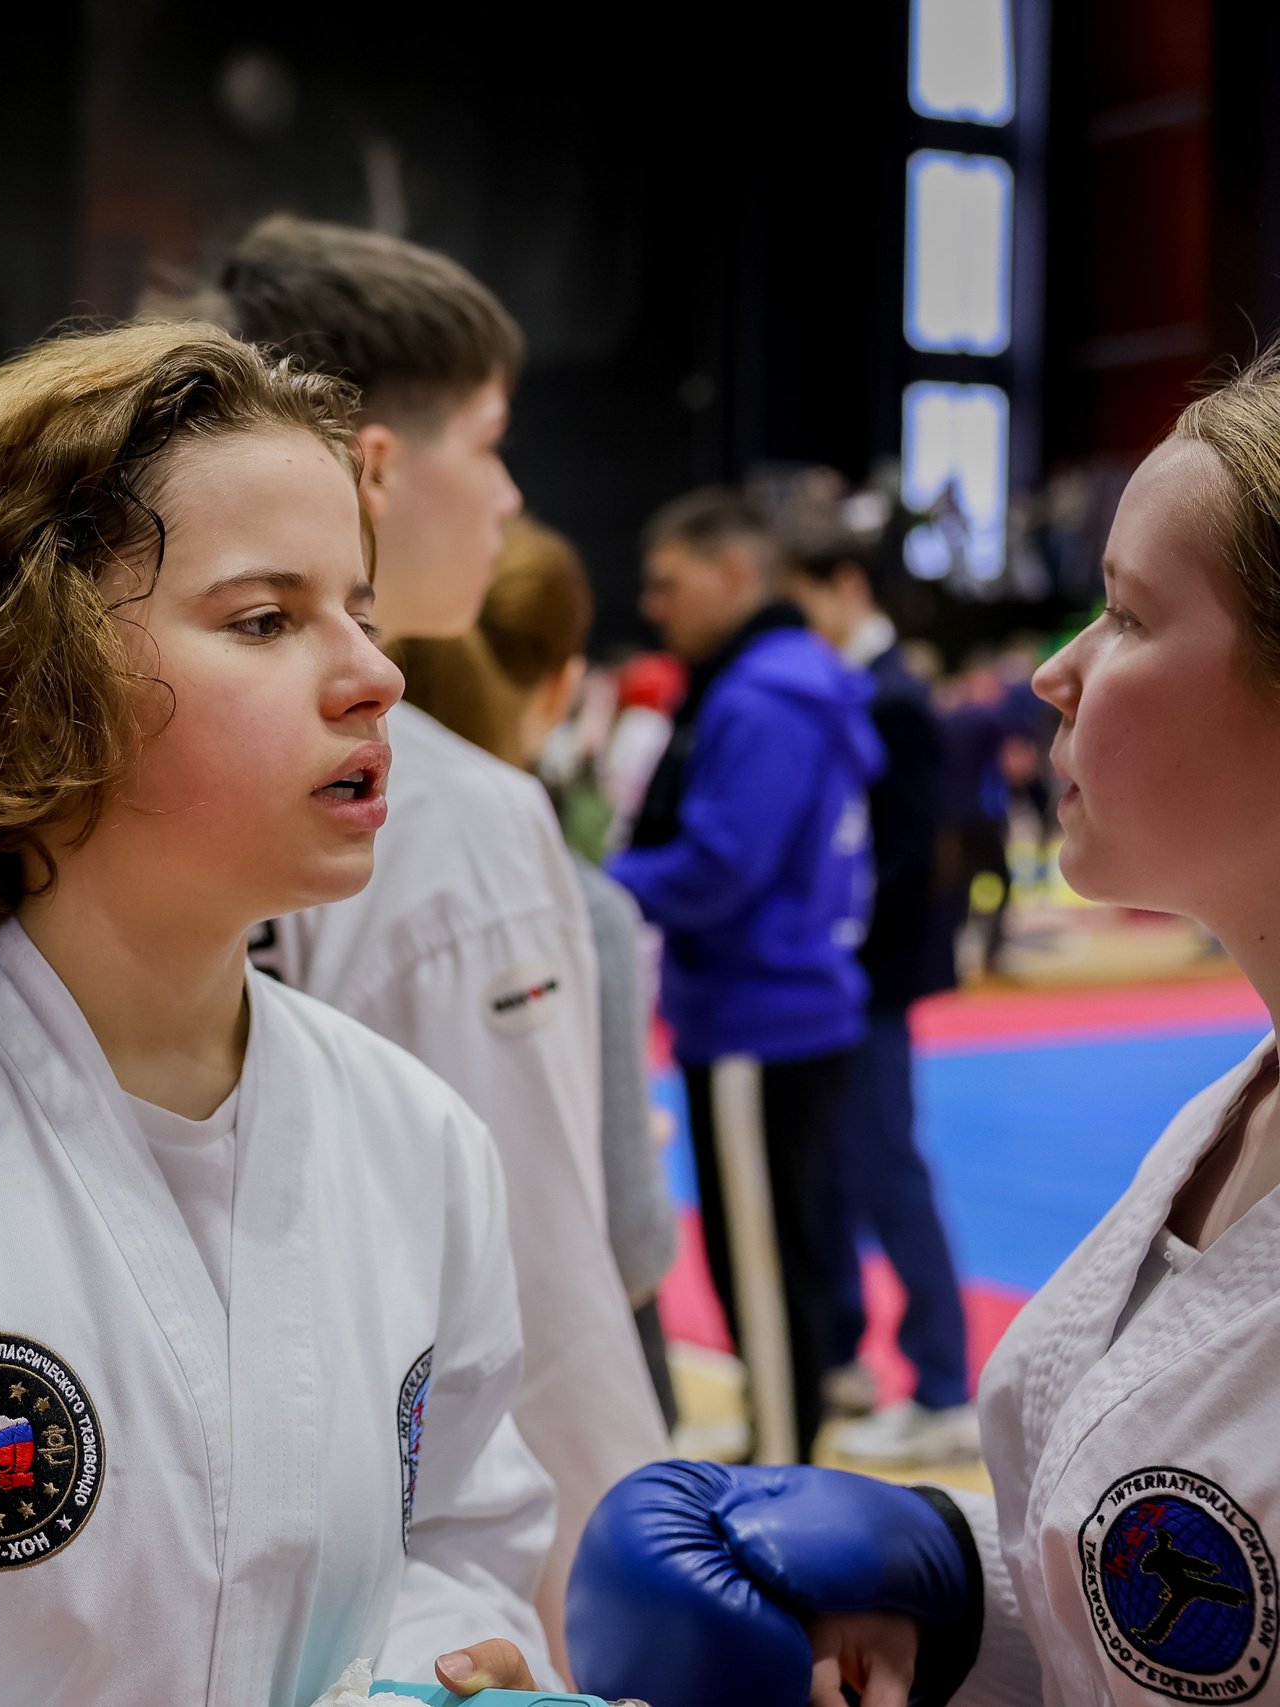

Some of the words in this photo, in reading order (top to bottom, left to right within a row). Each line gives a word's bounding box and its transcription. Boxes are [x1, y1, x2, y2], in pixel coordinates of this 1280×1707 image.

[74, 1413, 98, 1507] ТХЭКВОНДО
[1085, 1540, 1132, 1661] TAEKWON-DO
[1135, 1659, 1248, 1696] FEDERATION
[1108, 1474, 1237, 1526] INTERNATIONAL
[1239, 1528, 1274, 1648] CHANG-HON
